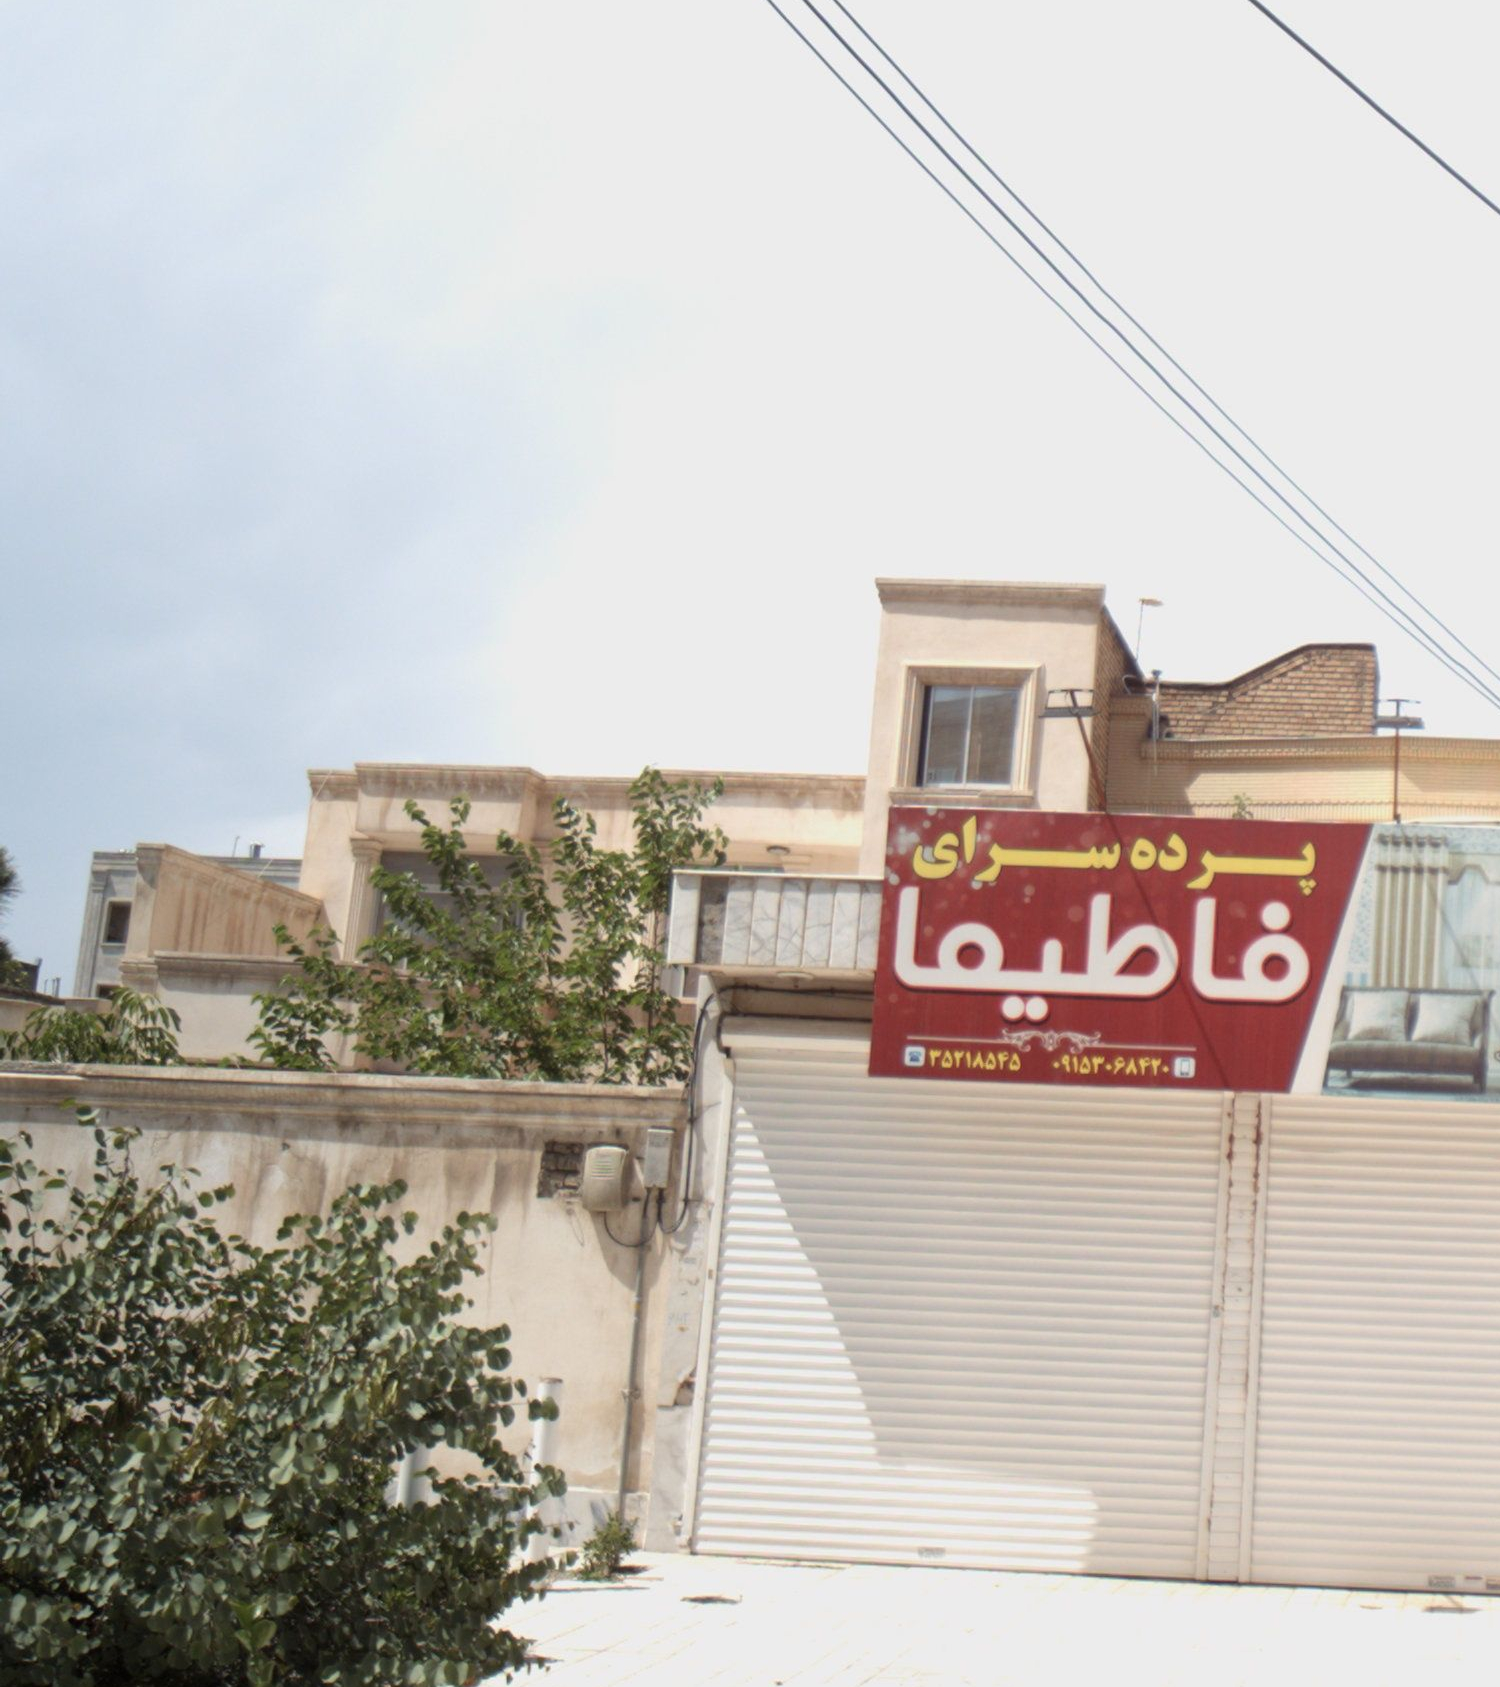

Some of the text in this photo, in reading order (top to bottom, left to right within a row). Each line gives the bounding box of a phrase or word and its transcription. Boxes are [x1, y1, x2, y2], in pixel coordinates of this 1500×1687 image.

[912, 814, 1317, 897] پرده سرای
[894, 885, 1311, 1022] فاطیما
[929, 1049, 1021, 1071] ۳۵۲۱۸۵۴۵
[1053, 1054, 1170, 1076] ۰۹۱۵۳۰۶۸۴۲۰
